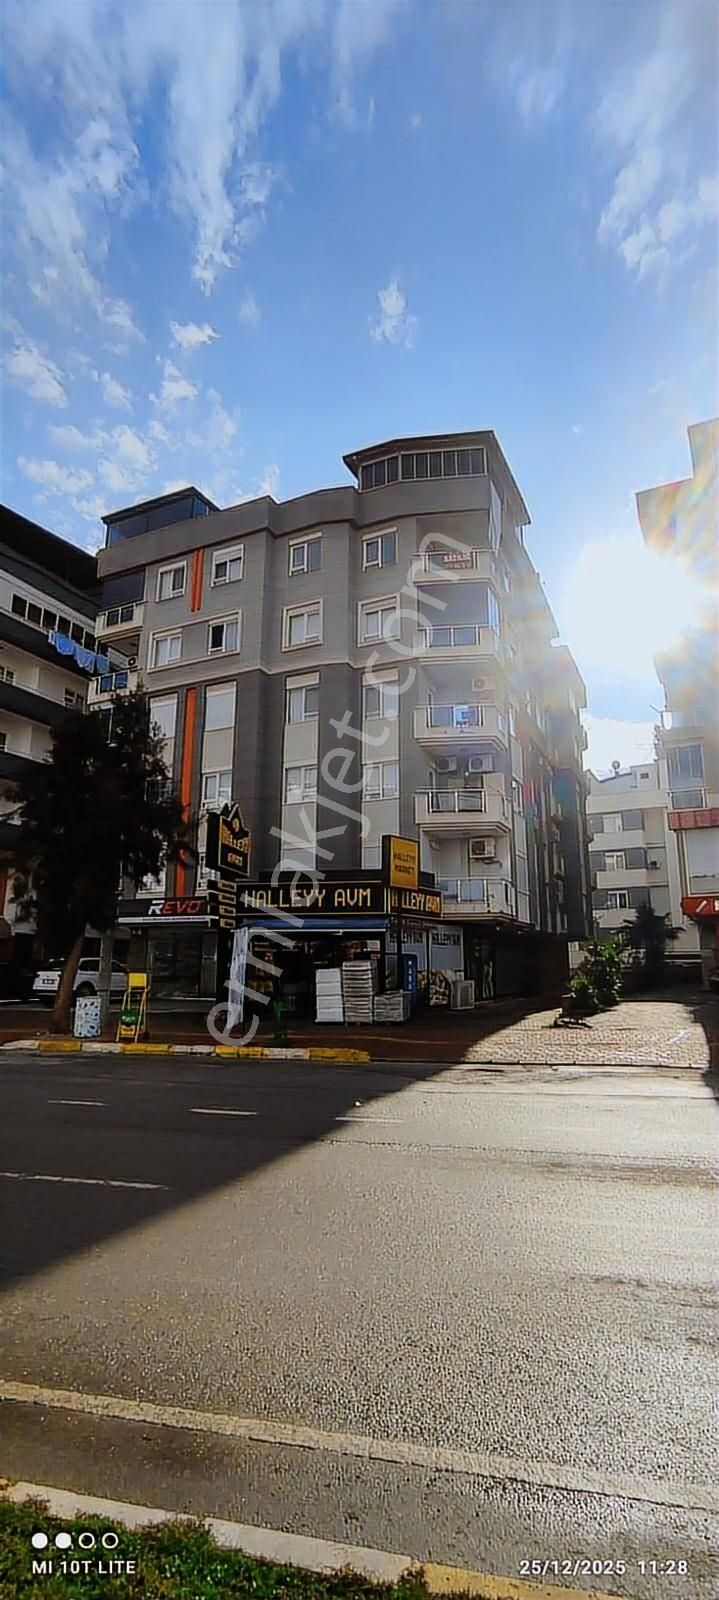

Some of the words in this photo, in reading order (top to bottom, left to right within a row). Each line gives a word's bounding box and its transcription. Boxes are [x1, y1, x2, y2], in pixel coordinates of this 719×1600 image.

[243, 888, 326, 908] HALLEYY
[334, 887, 371, 907] AVM
[148, 900, 202, 915] REVO
